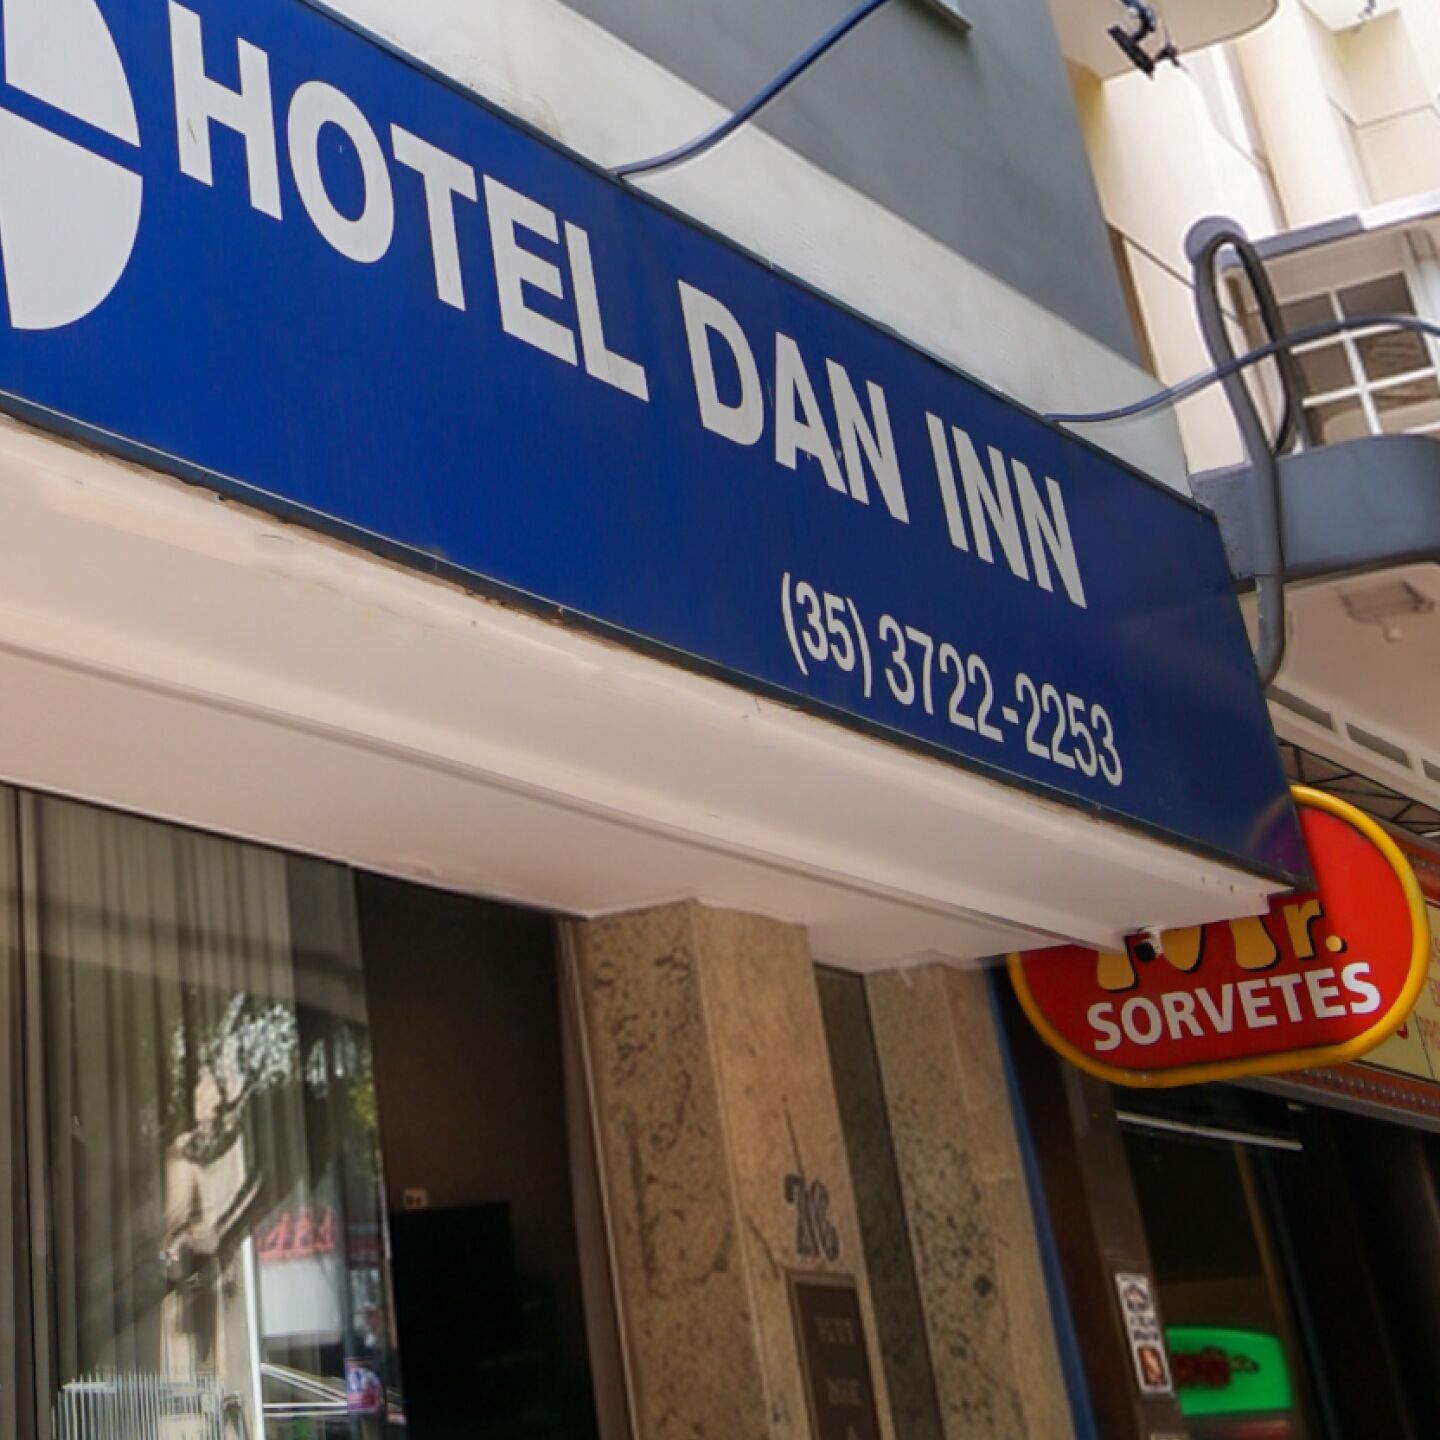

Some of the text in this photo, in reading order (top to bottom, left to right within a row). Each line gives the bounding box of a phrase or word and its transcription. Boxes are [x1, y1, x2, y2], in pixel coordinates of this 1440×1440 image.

[167, 0, 1087, 608] HOTEL DAN INN
[781, 572, 1123, 786] (35) 3722-2253
[1086, 962, 1381, 1051] SORVETES
